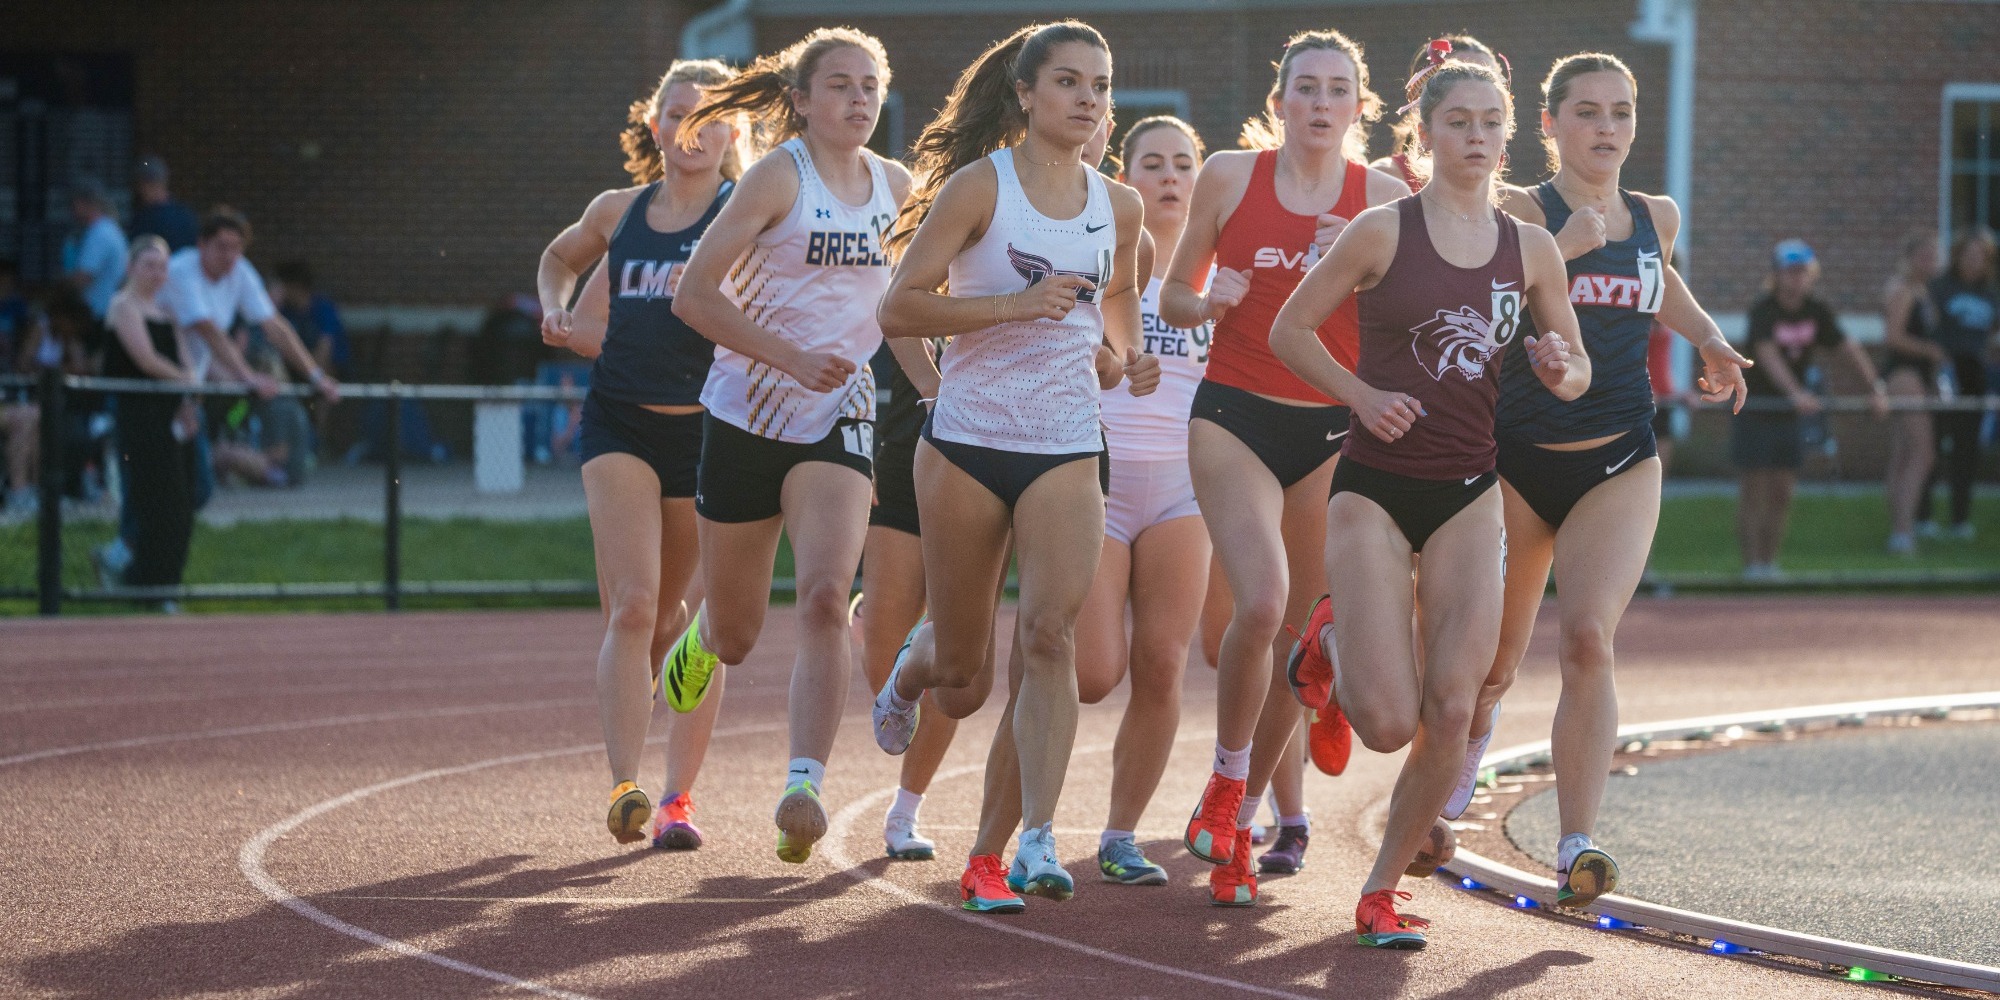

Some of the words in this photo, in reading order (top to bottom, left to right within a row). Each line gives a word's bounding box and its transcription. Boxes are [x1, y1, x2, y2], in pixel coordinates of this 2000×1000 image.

[1643, 261, 1660, 310] 7
[1191, 322, 1210, 363] 9
[1494, 293, 1516, 345] 8
